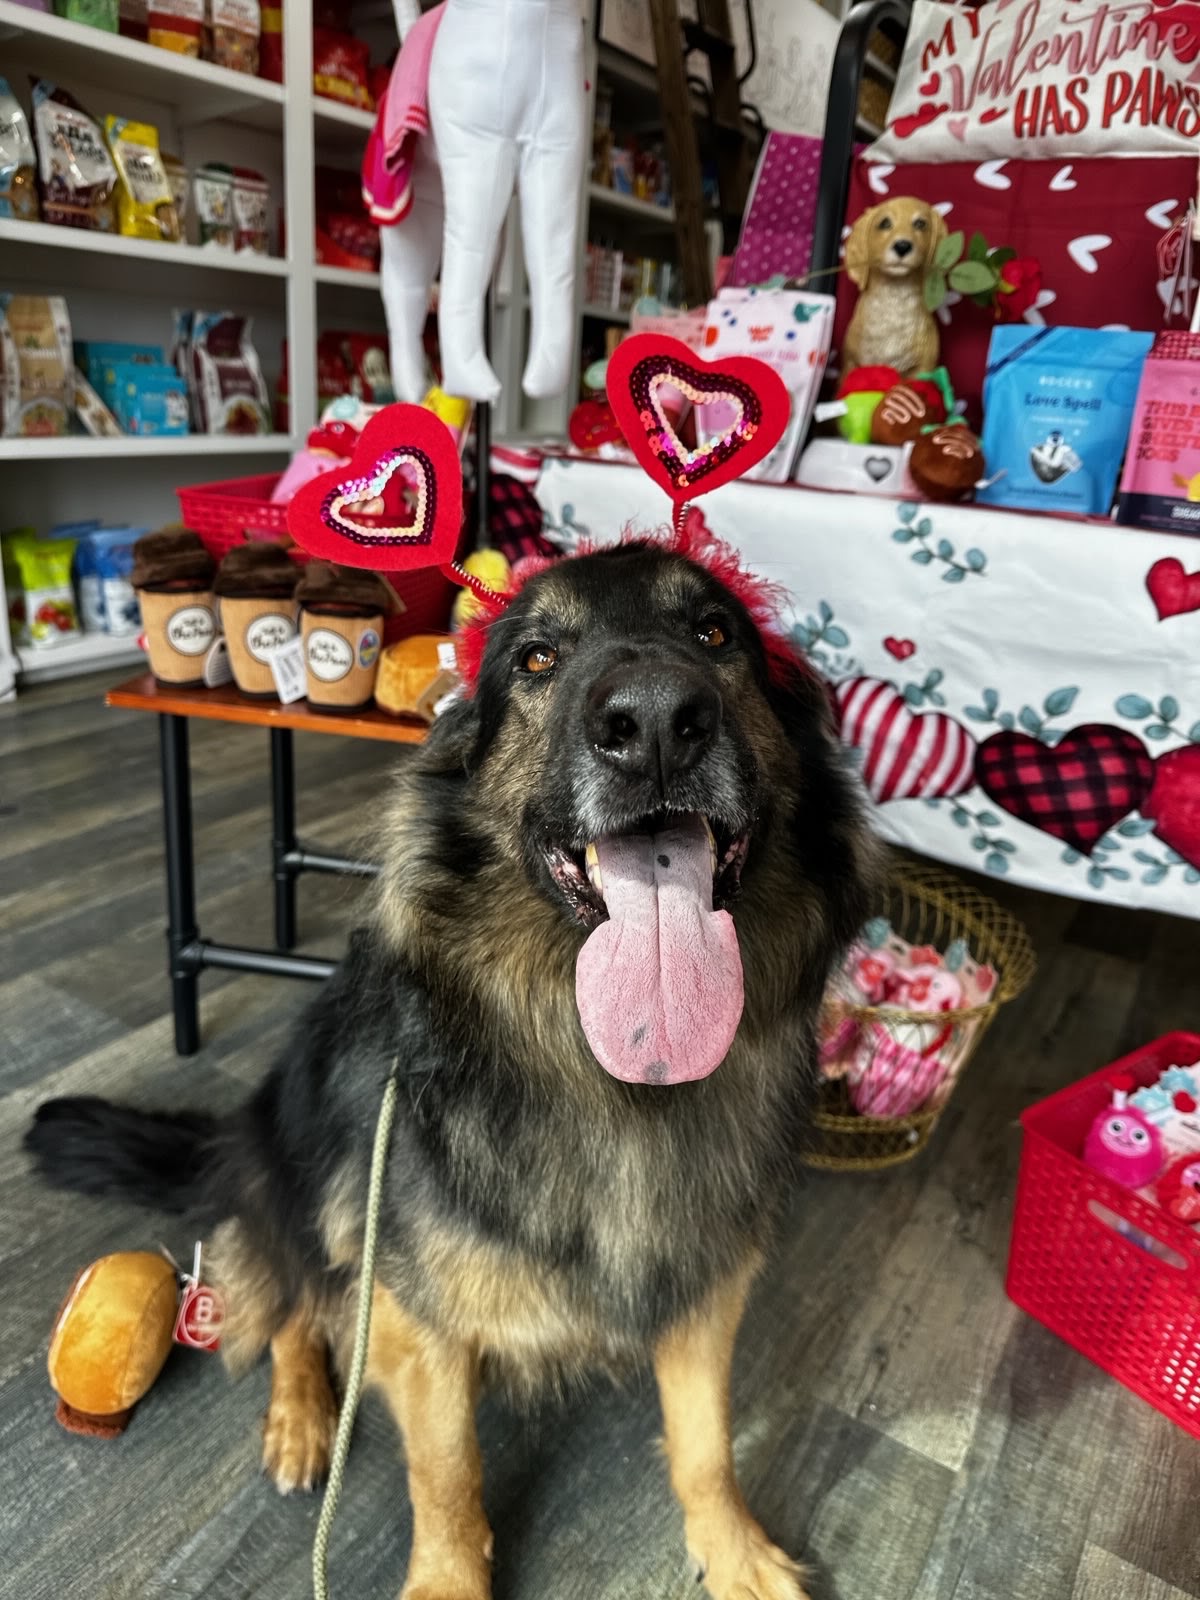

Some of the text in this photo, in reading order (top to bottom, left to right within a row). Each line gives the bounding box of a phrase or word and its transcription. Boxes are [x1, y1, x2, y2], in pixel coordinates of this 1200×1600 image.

[946, 0, 1197, 113] Valentine
[1014, 66, 1200, 138] HAS PAWS
[1024, 391, 1102, 413] Love Spell
